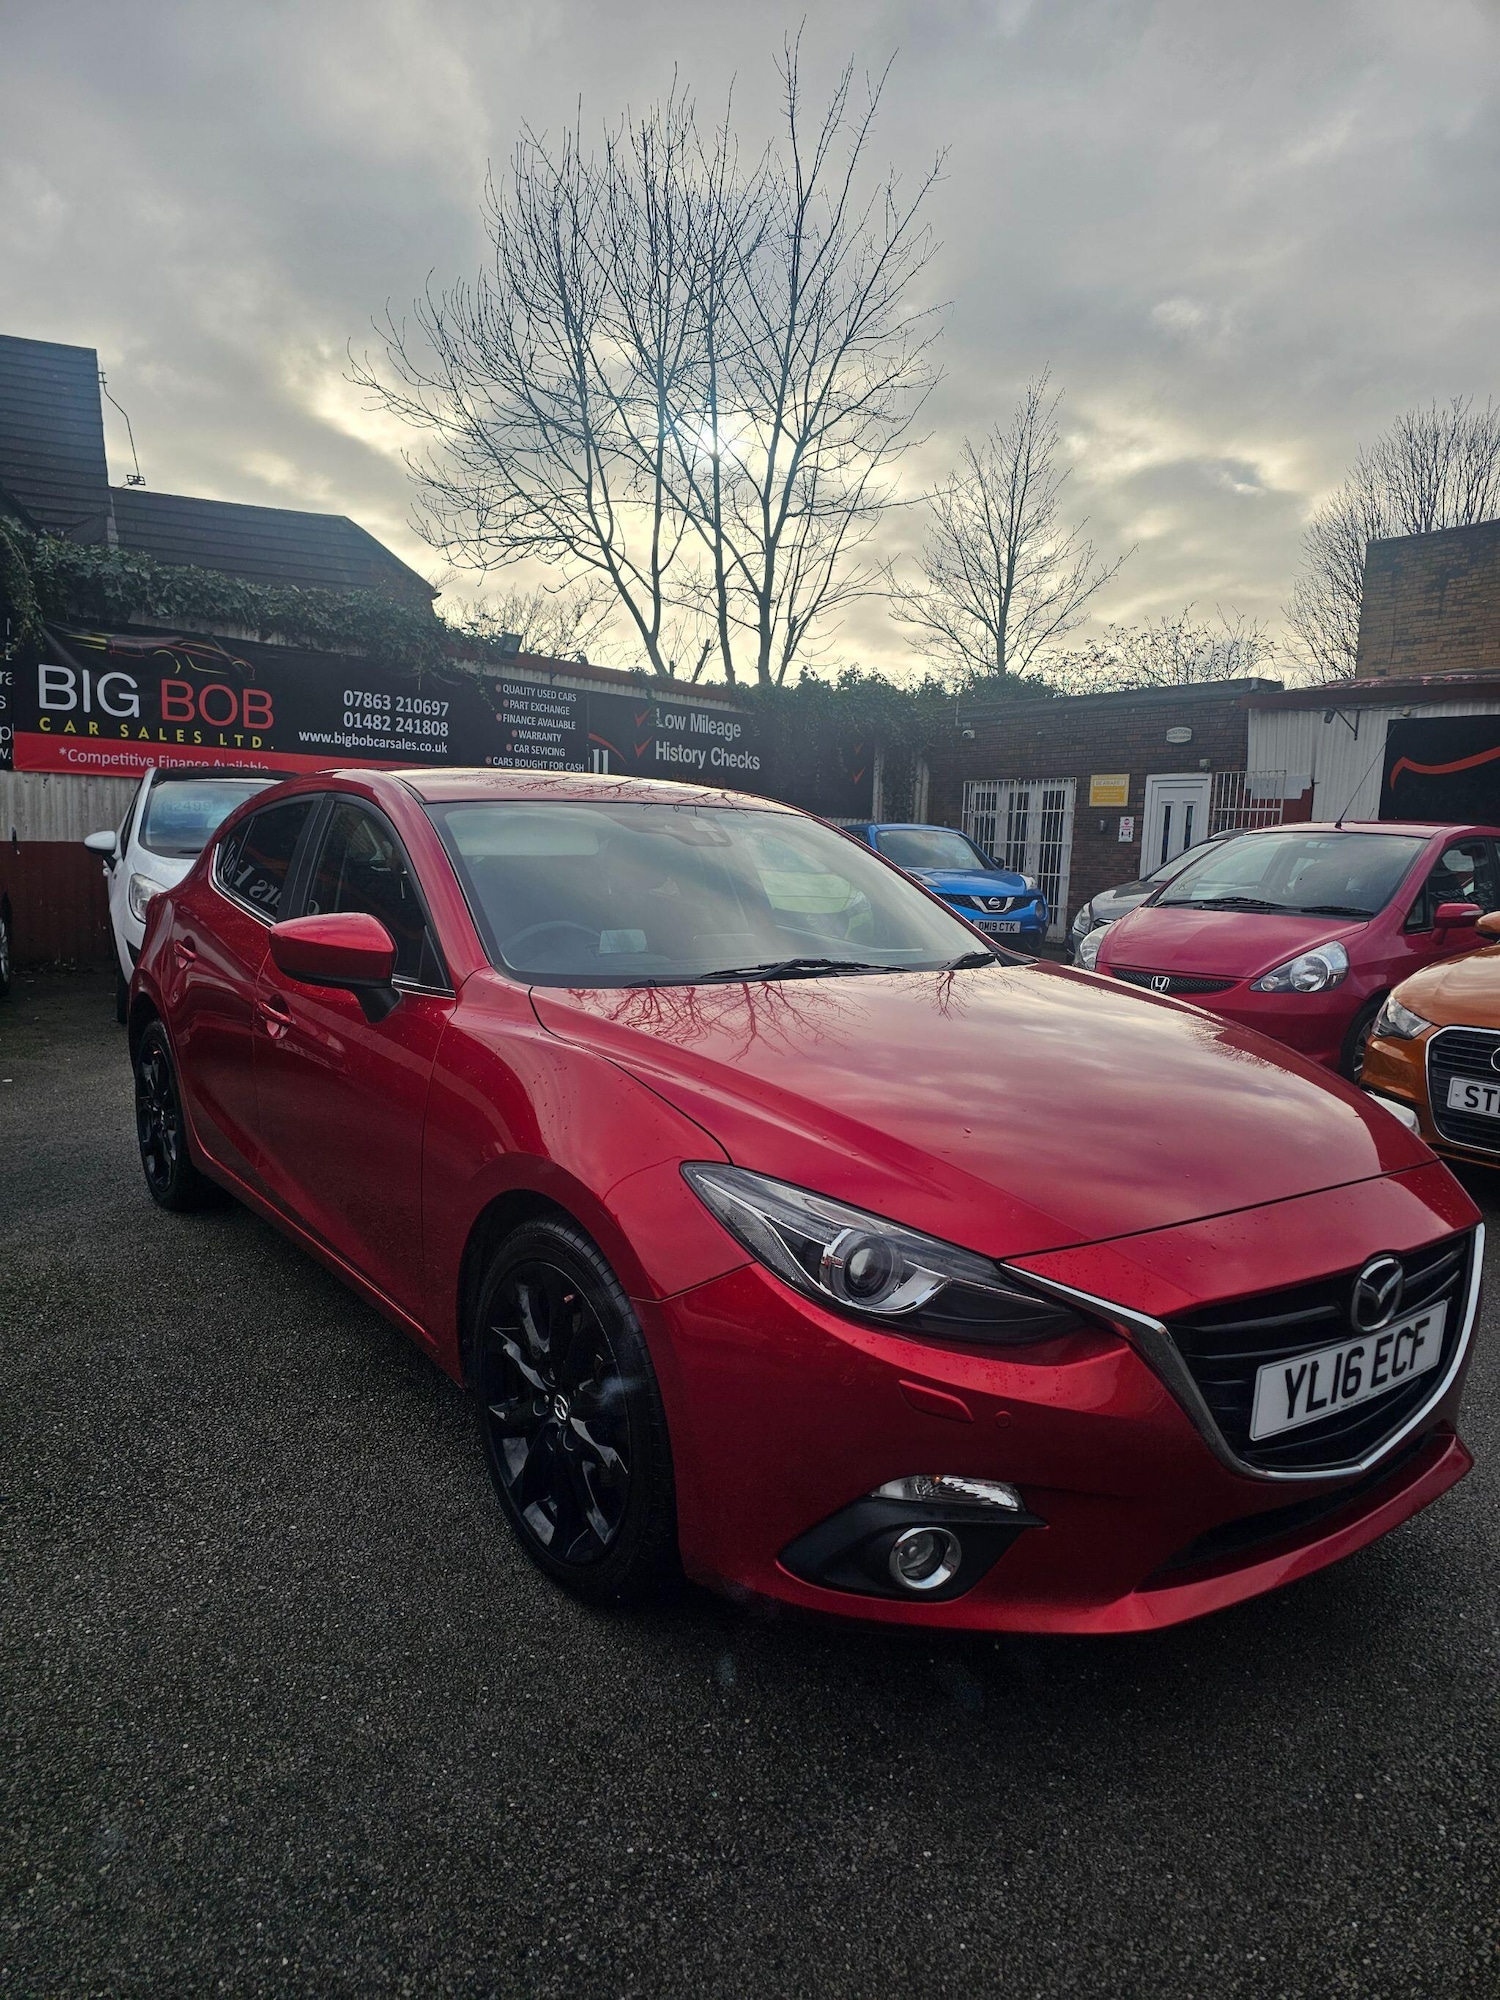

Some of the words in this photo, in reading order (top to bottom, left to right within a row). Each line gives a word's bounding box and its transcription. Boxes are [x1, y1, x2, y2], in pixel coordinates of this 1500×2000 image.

[38, 664, 140, 718] BIG
[160, 678, 274, 730] BOB
[343, 689, 391, 710] 07863
[395, 696, 449, 717] 210697
[502, 684, 535, 698] QUALITY
[537, 688, 557, 700] USED
[558, 690, 577, 702] CARS
[509, 700, 529, 712] PART
[530, 702, 570, 716] EXCHANGE
[39, 717, 99, 736] CAR
[120, 723, 202, 745] SALES
[219, 732, 275, 750] LTD.
[343, 711, 391, 732] 01482
[395, 716, 449, 737] 241808
[502, 713, 536, 727] FINANCE
[537, 717, 576, 730] AVALIABLE
[655, 707, 686, 730] Low
[690, 713, 742, 742] Mileage
[298, 730, 448, 754] www.bigbobcarsales.co.uk
[518, 730, 562, 743] WARRANTY
[158, 755, 209, 769] Finance
[513, 743, 530, 755] CAR
[530, 744, 566, 757] SEVICING
[655, 741, 706, 770] History
[710, 747, 760, 771] Checks
[493, 756, 513, 768] CARS
[514, 758, 548, 770] BOUGHT
[549, 760, 564, 772] FOR
[565, 761, 585, 773] CASH
[999, 922, 1016, 932] CTK
[1464, 1085, 1500, 1113] ST
[1284, 1346, 1364, 1419] YL16
[1370, 1317, 1430, 1389] ECF
